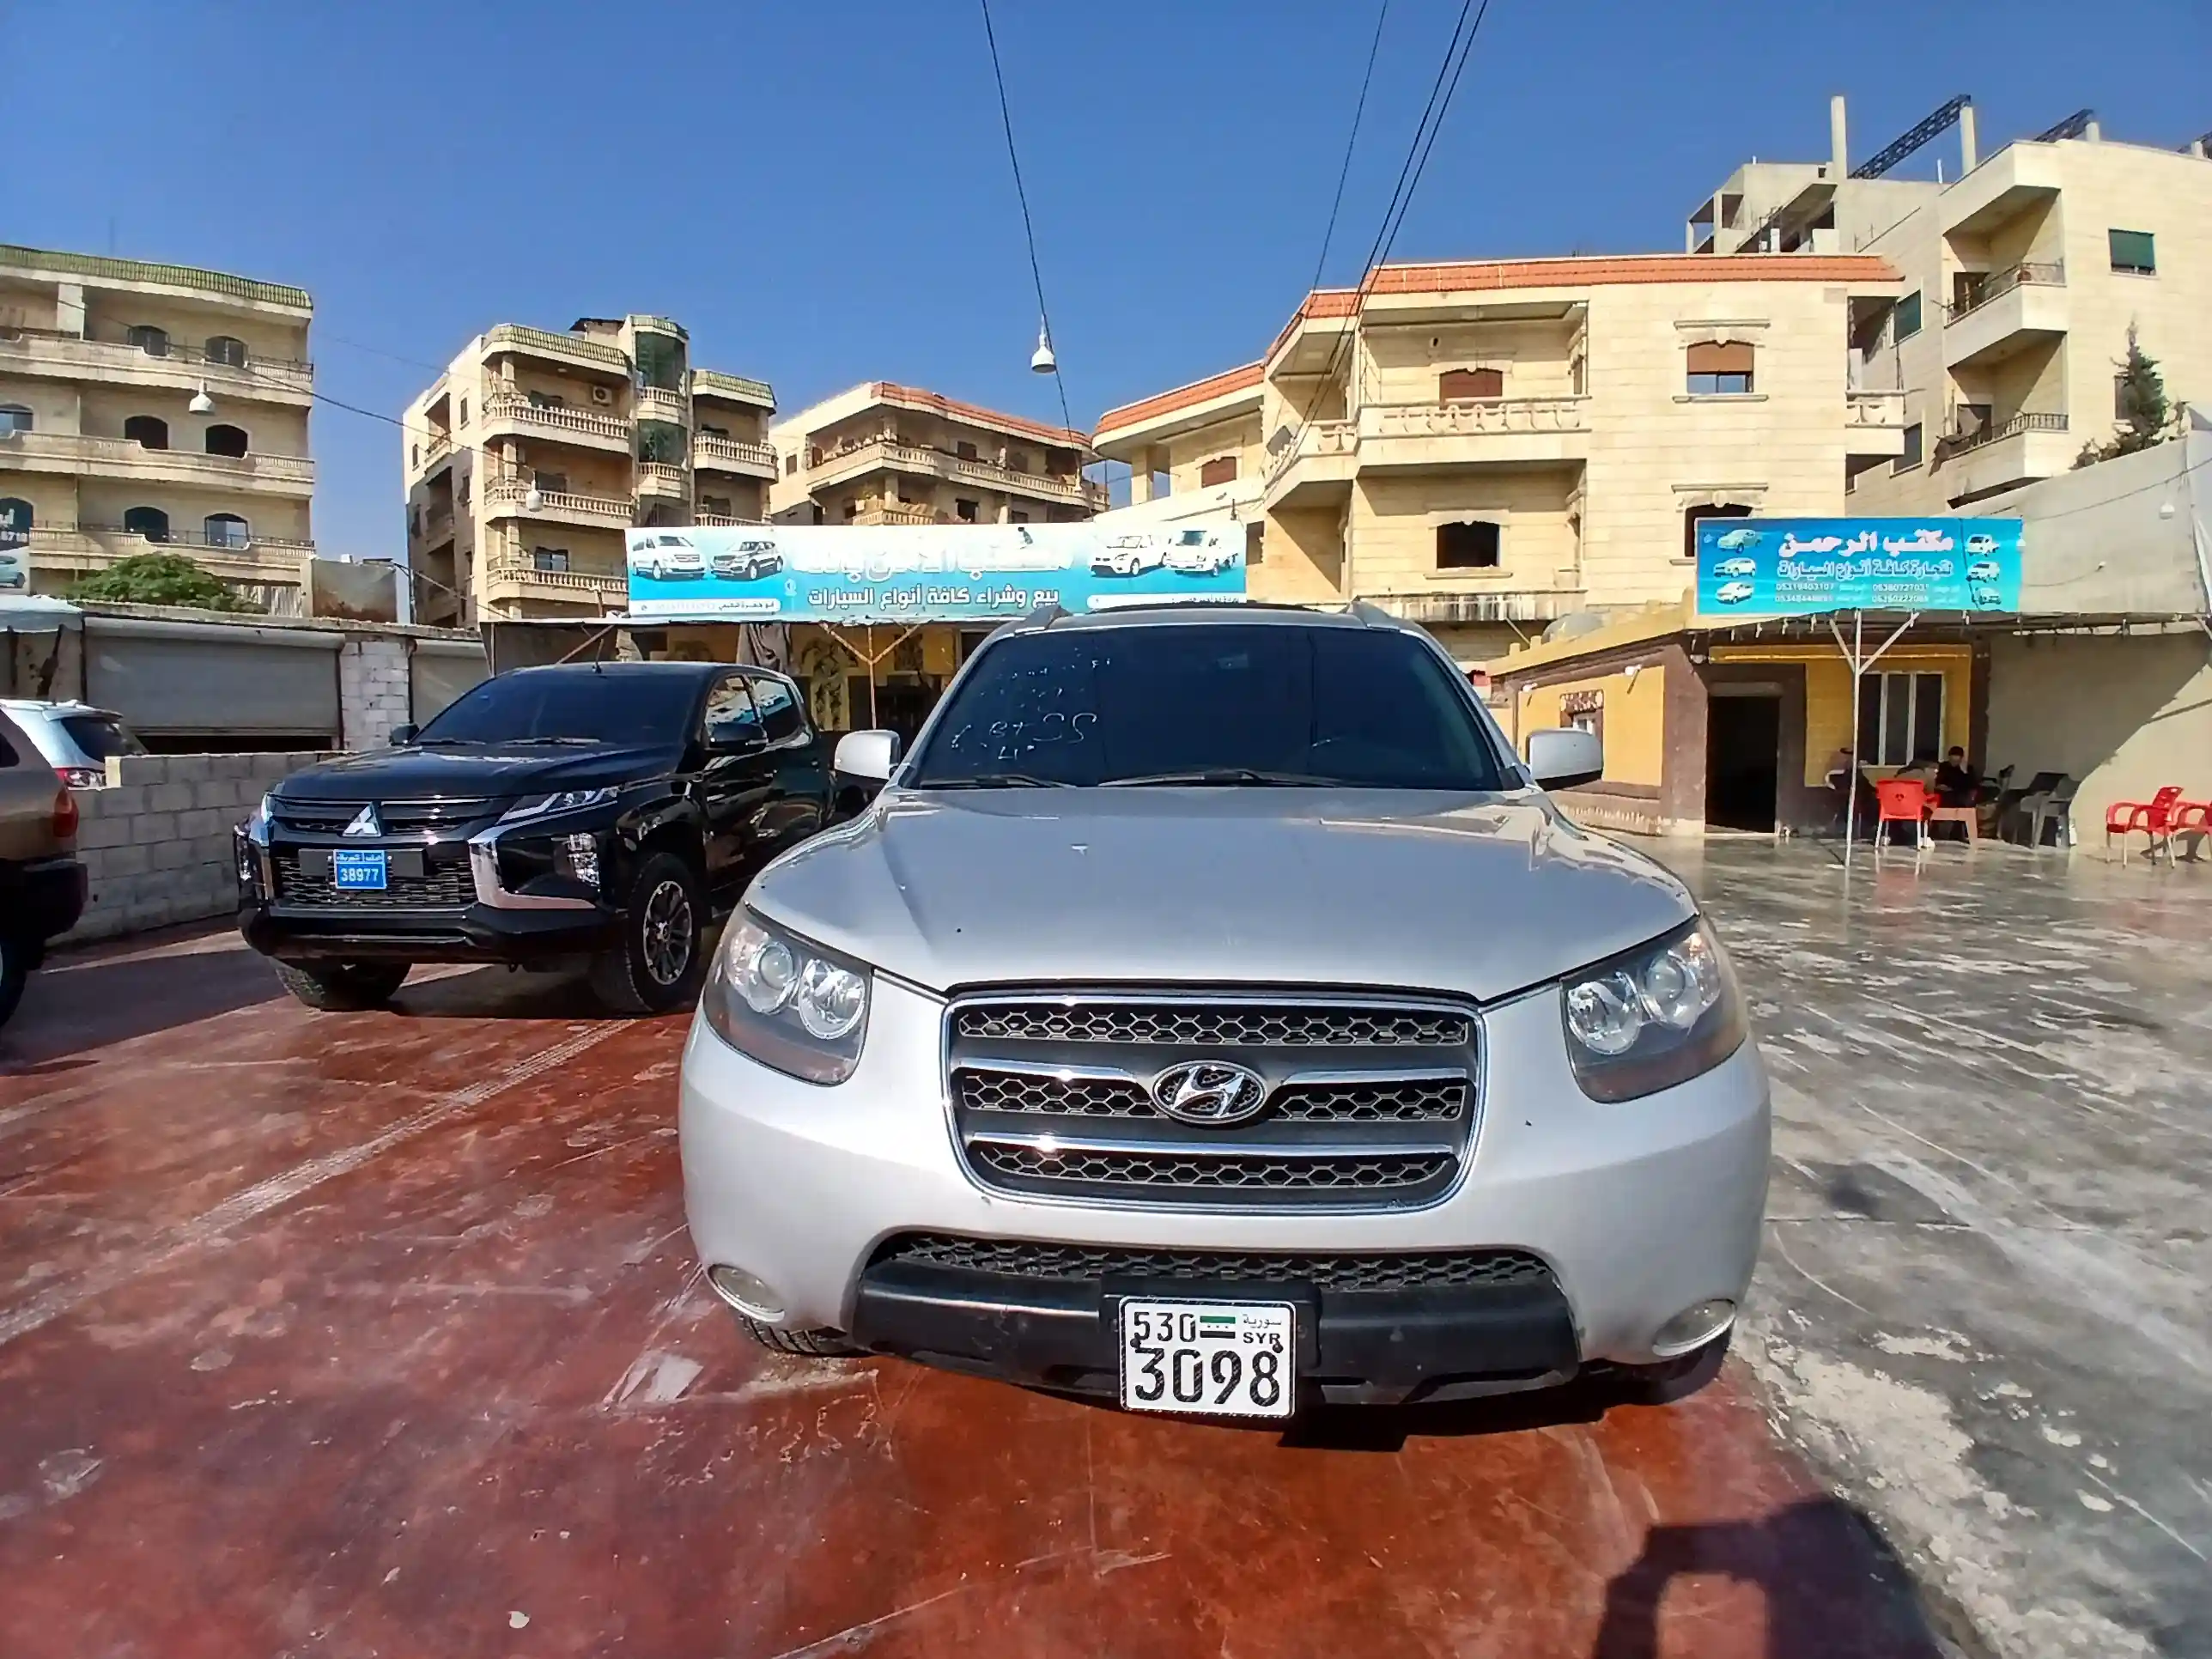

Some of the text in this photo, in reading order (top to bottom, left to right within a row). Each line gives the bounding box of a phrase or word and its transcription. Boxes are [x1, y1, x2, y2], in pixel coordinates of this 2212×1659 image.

[1778, 529, 1954, 557] مكتب الرحمن
[1777, 560, 1835, 580] السيارات
[1873, 558, 1911, 577] كافة
[808, 583, 1060, 611] بيع وشراء كافة أنواع السيارات
[340, 867, 379, 882] 38977
[1133, 1311, 1196, 1342] 530
[1243, 1313, 1282, 1328] سورية
[1243, 1332, 1281, 1345] SYR
[1134, 1347, 1280, 1407] 3098
